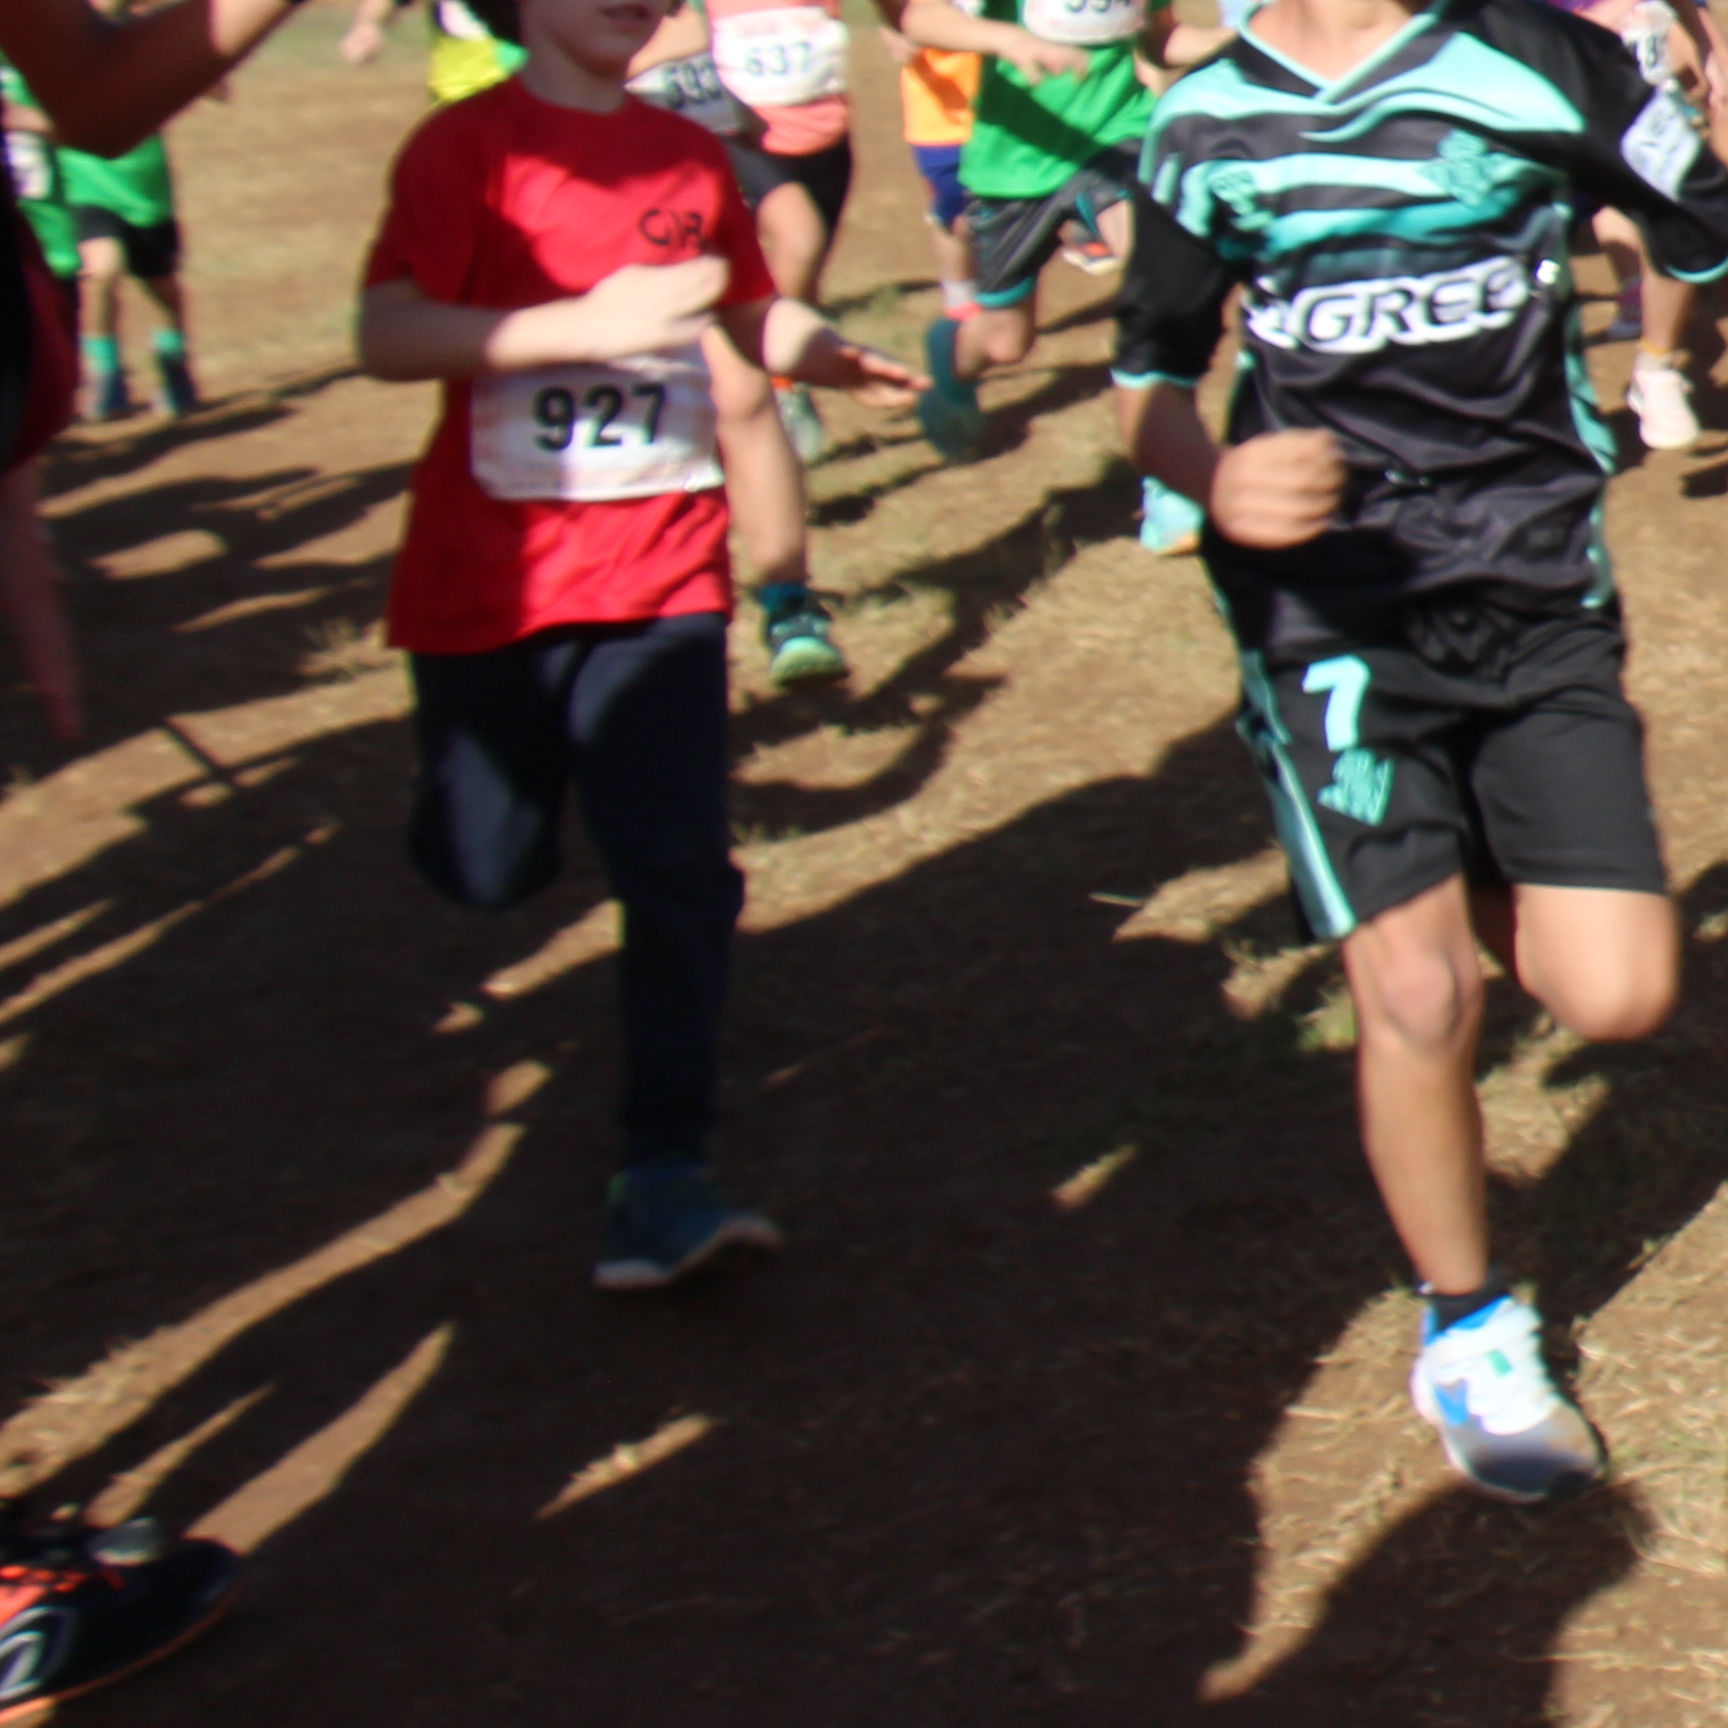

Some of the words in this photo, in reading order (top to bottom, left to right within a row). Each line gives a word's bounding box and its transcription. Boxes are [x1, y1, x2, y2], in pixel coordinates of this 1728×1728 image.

[744, 41, 810, 77] 637
[533, 384, 666, 453] 927
[1303, 654, 1372, 753] 7
